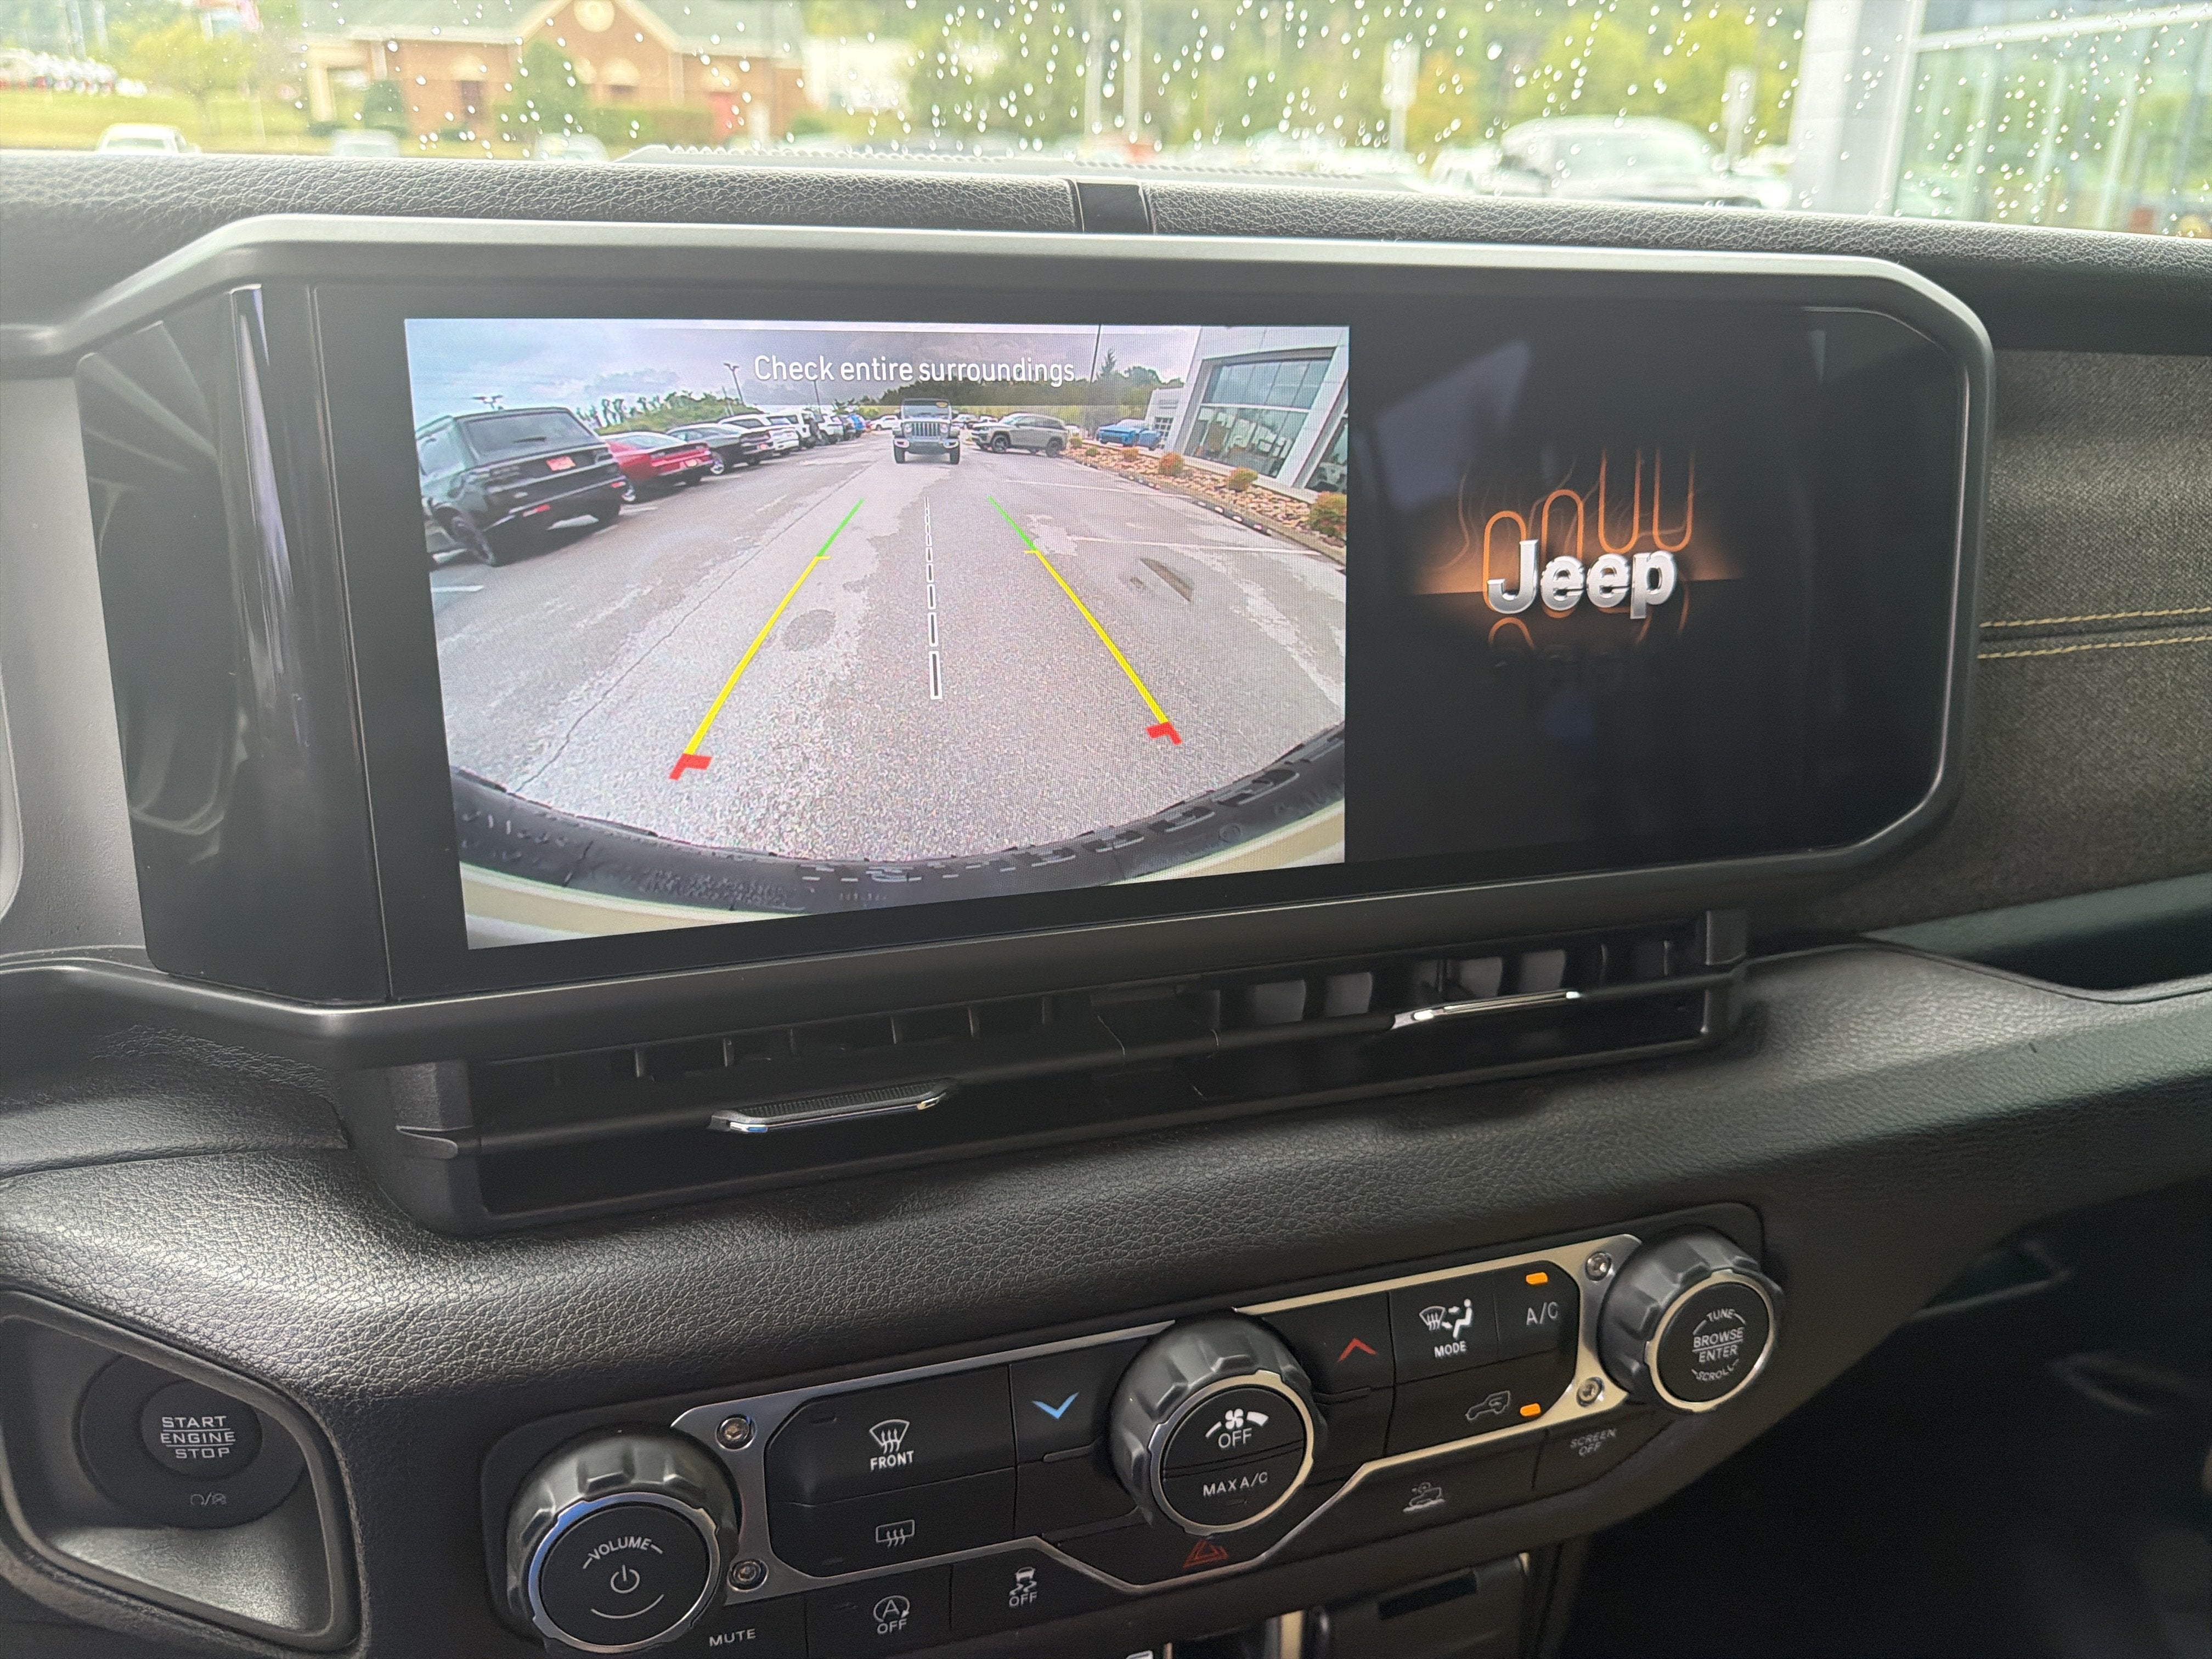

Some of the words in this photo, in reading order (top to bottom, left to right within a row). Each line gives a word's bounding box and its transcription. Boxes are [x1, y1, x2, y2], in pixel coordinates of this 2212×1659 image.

[754, 356, 834, 381] Check
[840, 357, 913, 381] entire
[918, 357, 1075, 387] surroundings
[1487, 539, 1677, 619] Jeep
[1526, 1301, 1559, 1326] A/C
[1706, 1308, 1735, 1322] TUNE
[1693, 1327, 1743, 1347] BROWSE
[1434, 1340, 1467, 1358] MODE
[1699, 1345, 1738, 1363] ENTER
[162, 1415, 227, 1428] START
[161, 1431, 236, 1444] ENGINE
[1218, 1427, 1252, 1449] OFF
[175, 1447, 230, 1459] STOP
[1578, 1441, 1601, 1456] OFF
[870, 1451, 915, 1471] FRONT
[1203, 1480, 1237, 1497] MAX
[1240, 1472, 1268, 1489] A/C
[588, 1536, 652, 1560] VOLUME
[1009, 1593, 1037, 1607] OFF
[877, 1618, 907, 1634] OFF
[709, 1628, 757, 1647] MUTE
